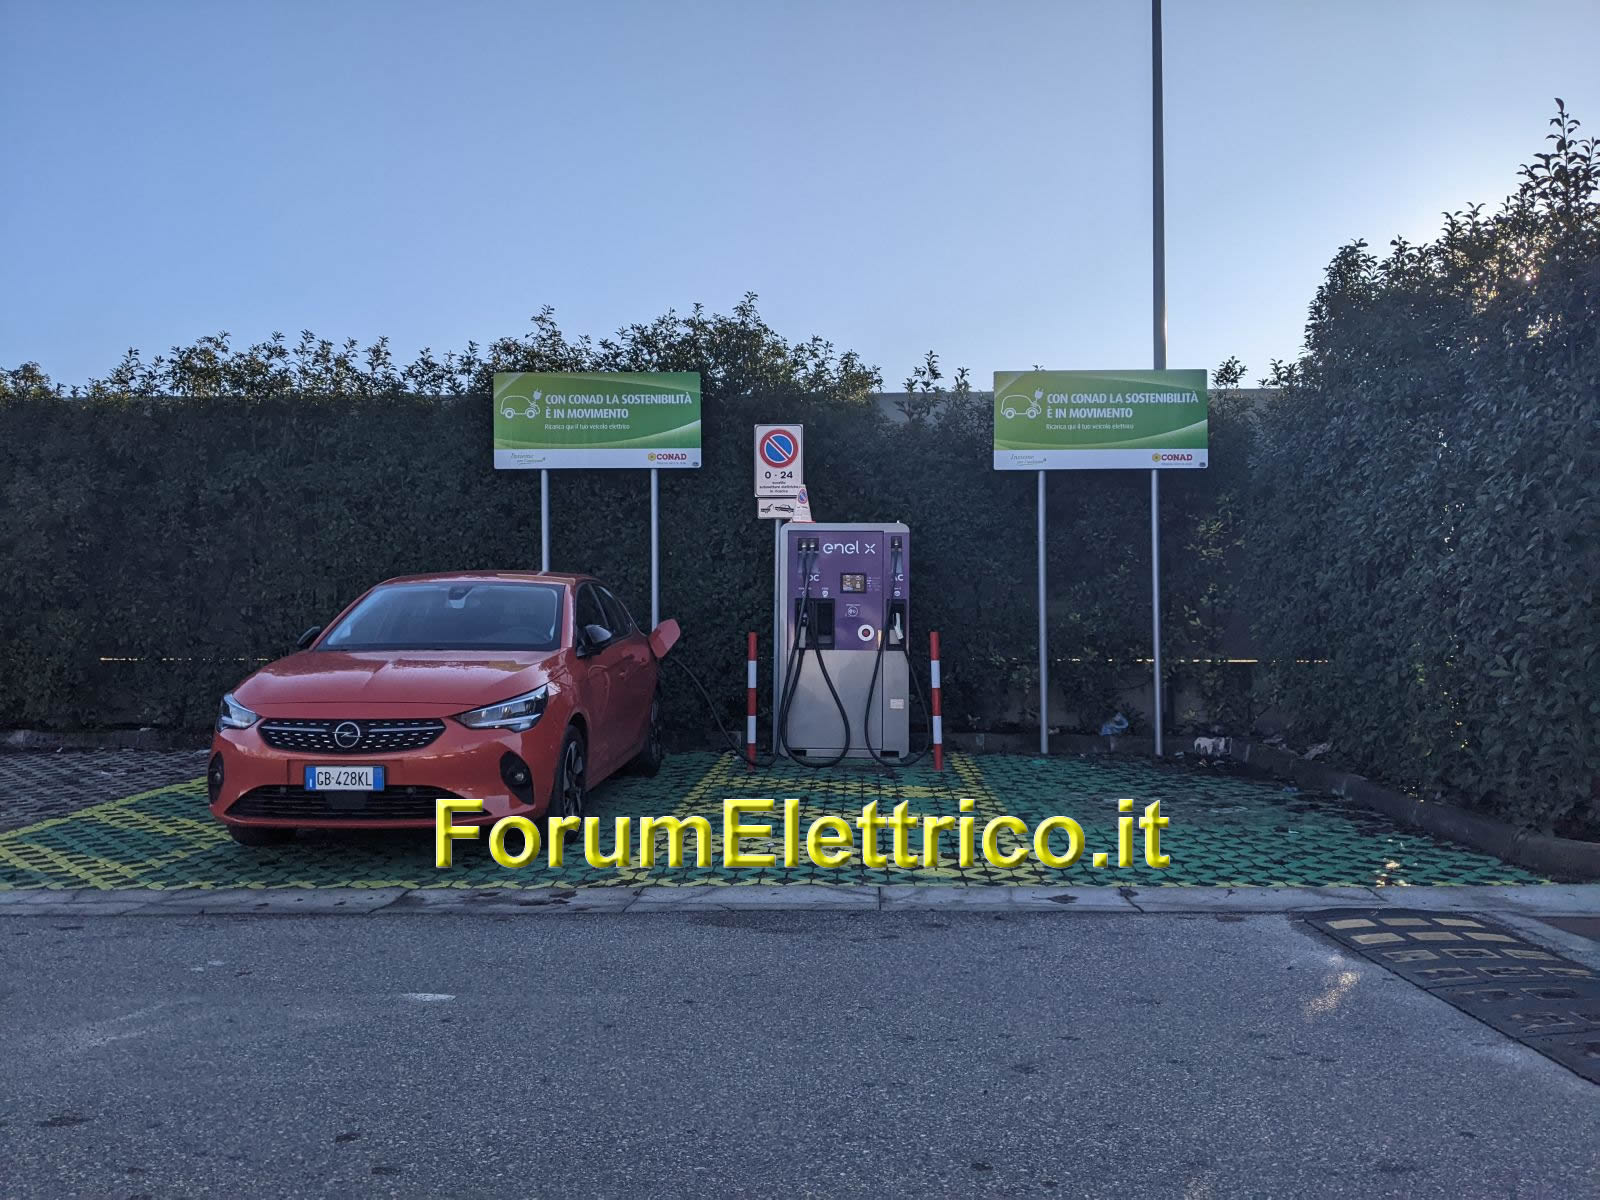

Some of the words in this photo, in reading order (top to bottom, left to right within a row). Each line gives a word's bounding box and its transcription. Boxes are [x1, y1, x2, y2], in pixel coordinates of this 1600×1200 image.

[545, 394, 566, 405] CON
[568, 394, 604, 405] CONAD
[606, 394, 620, 405] LA
[621, 391, 693, 405] SOSTENIBILITÀ
[1047, 393, 1069, 404] CON
[1070, 393, 1107, 404] CONAD
[1109, 393, 1123, 404] LA
[1125, 390, 1199, 404] SOSTENIBILITÀ
[545, 406, 552, 419] È
[553, 408, 565, 419] IN
[567, 408, 629, 419] MOVIMENTO
[1047, 405, 1053, 419] È
[1055, 407, 1067, 419] IN
[1069, 407, 1133, 419] MOVIMENTO
[656, 453, 688, 461] CONAD
[764, 471, 772, 479] 0
[780, 471, 793, 479] 24
[822, 540, 860, 554] enel
